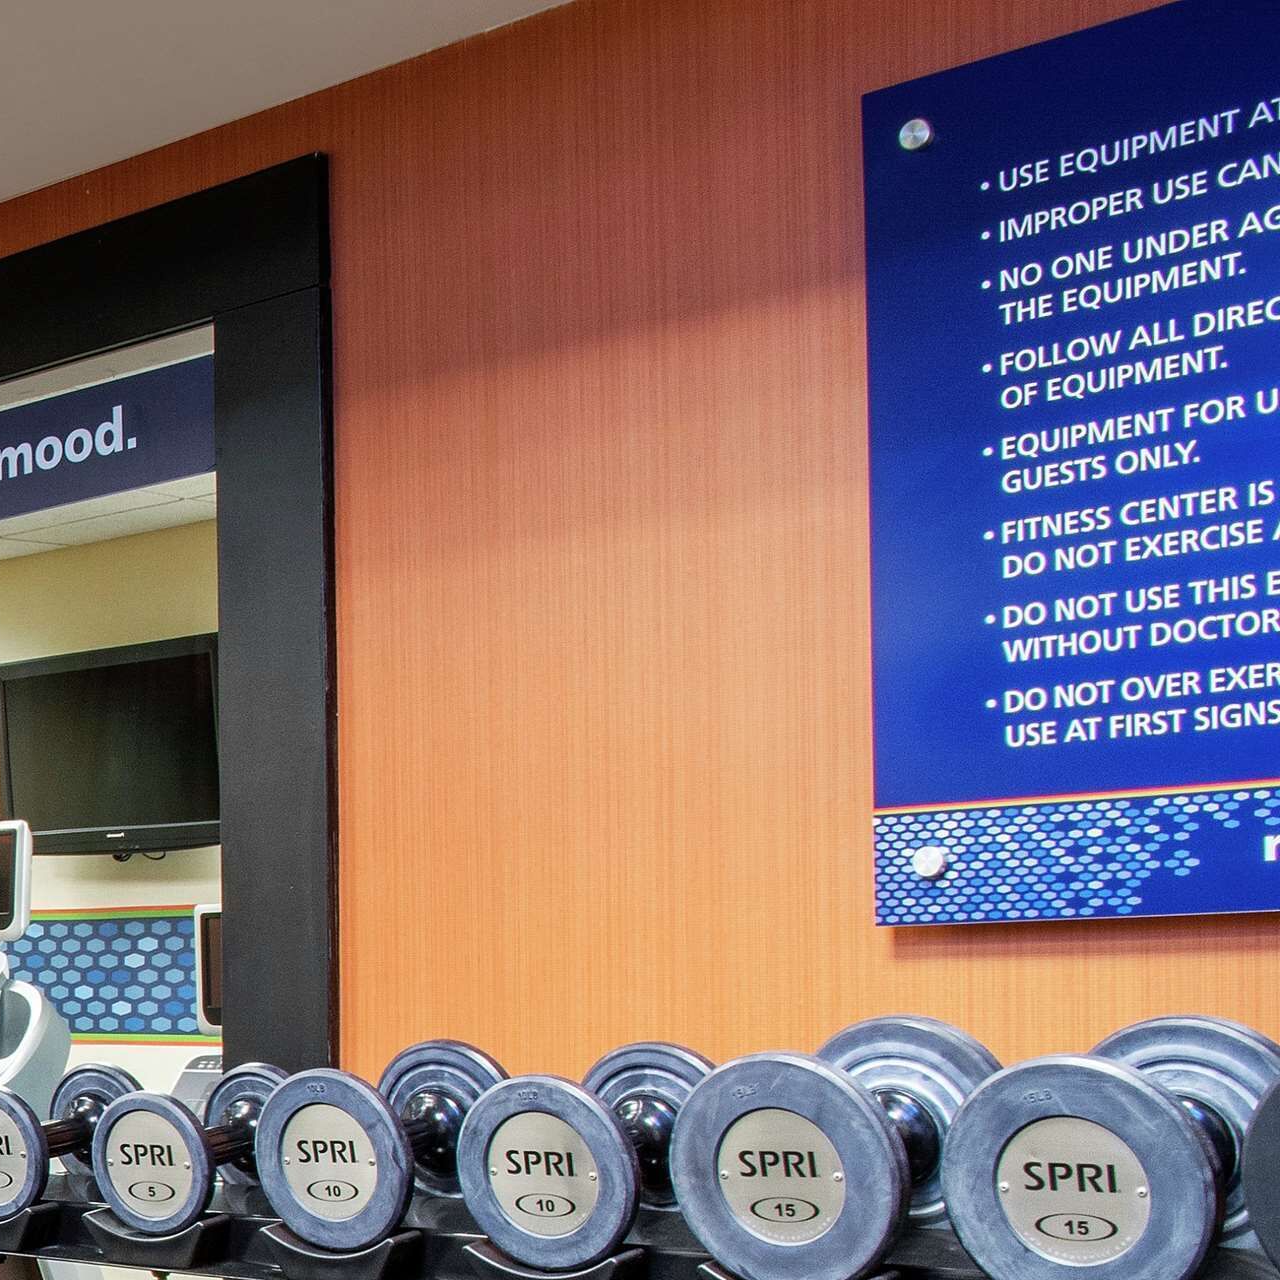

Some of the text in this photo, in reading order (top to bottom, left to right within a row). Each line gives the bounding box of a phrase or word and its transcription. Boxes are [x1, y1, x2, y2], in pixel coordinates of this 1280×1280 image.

[999, 159, 1050, 192] USE
[1060, 108, 1241, 177] EQUIPMENT
[999, 188, 1144, 243] IMPROPER
[1153, 170, 1208, 205] USE
[1000, 262, 1043, 292] NO
[1051, 245, 1113, 279] ONE
[1123, 219, 1230, 264] UNDER
[998, 251, 1247, 325] THE EQUIPMENT.
[1000, 329, 1122, 376] FOLLOW
[1128, 318, 1185, 351] ALL
[1001, 344, 1228, 409] OF EQUIPMENT.
[1001, 387, 1279, 460] EQUIPMENT FOR U
[1001, 439, 1201, 494] GUESTS ONLY.
[1002, 479, 1275, 545] FITNESS CENTER IS
[1002, 551, 1047, 579] DO
[1054, 539, 1118, 572] NOT
[1125, 518, 1264, 562] EXERCISE
[1002, 601, 1048, 629] DO
[1054, 591, 1119, 623] NOT
[1125, 583, 1181, 614] USE
[1187, 573, 1257, 605] THIS
[1002, 624, 1143, 663] WITHOUT
[1004, 686, 1048, 714] DO
[1053, 679, 1116, 709] NOT
[1121, 671, 1202, 702] OVER
[1005, 720, 1058, 748] USE
[1063, 716, 1103, 743] AT
[1109, 708, 1187, 739] FIRST
[119, 1143, 174, 1167] SPRI
[296, 1139, 357, 1164] SPRI
[505, 1149, 575, 1178] SPRI
[738, 1150, 818, 1178] SPRI
[148, 1186, 156, 1198] 5
[324, 1185, 342, 1198] 10
[1023, 1161, 1118, 1194] SPRI
[535, 1199, 555, 1213] 10
[774, 1203, 796, 1218] 15
[1064, 1220, 1090, 1236] 15
